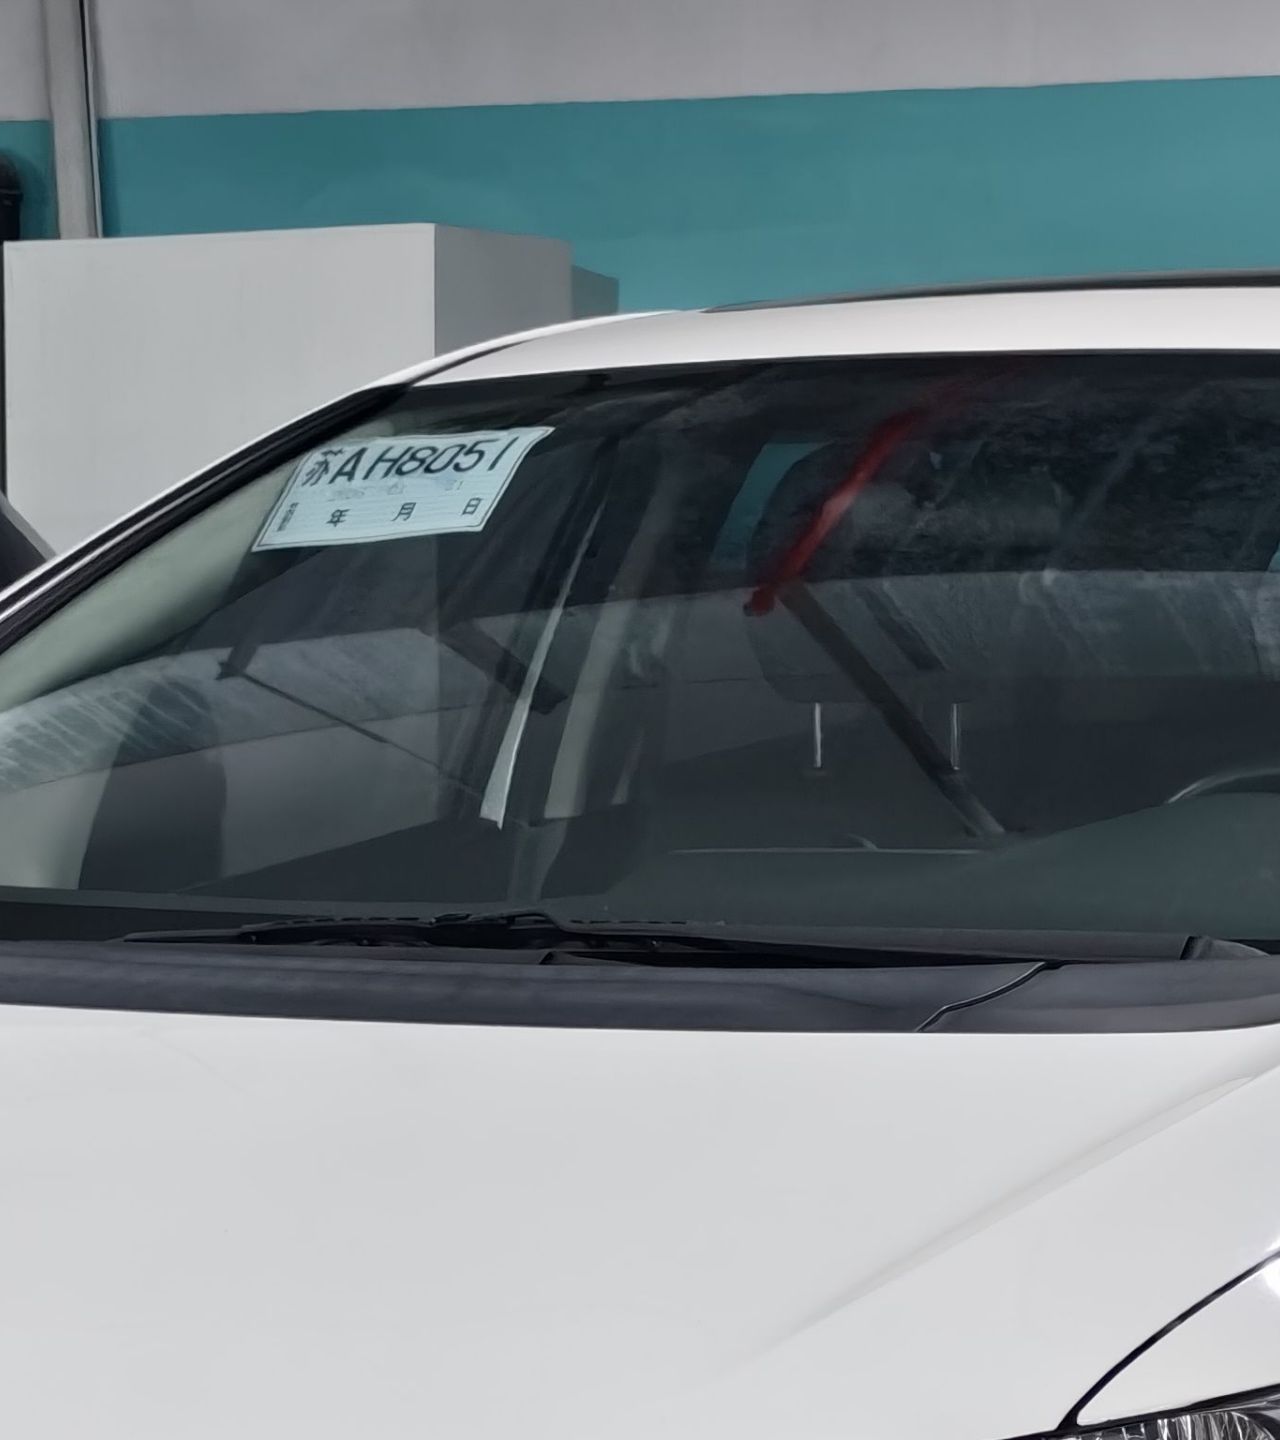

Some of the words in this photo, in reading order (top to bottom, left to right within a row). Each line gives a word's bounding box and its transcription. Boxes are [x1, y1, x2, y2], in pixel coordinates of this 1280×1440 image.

[326, 508, 350, 527] 年
[391, 502, 417, 522] 月
[461, 497, 483, 516] 日
